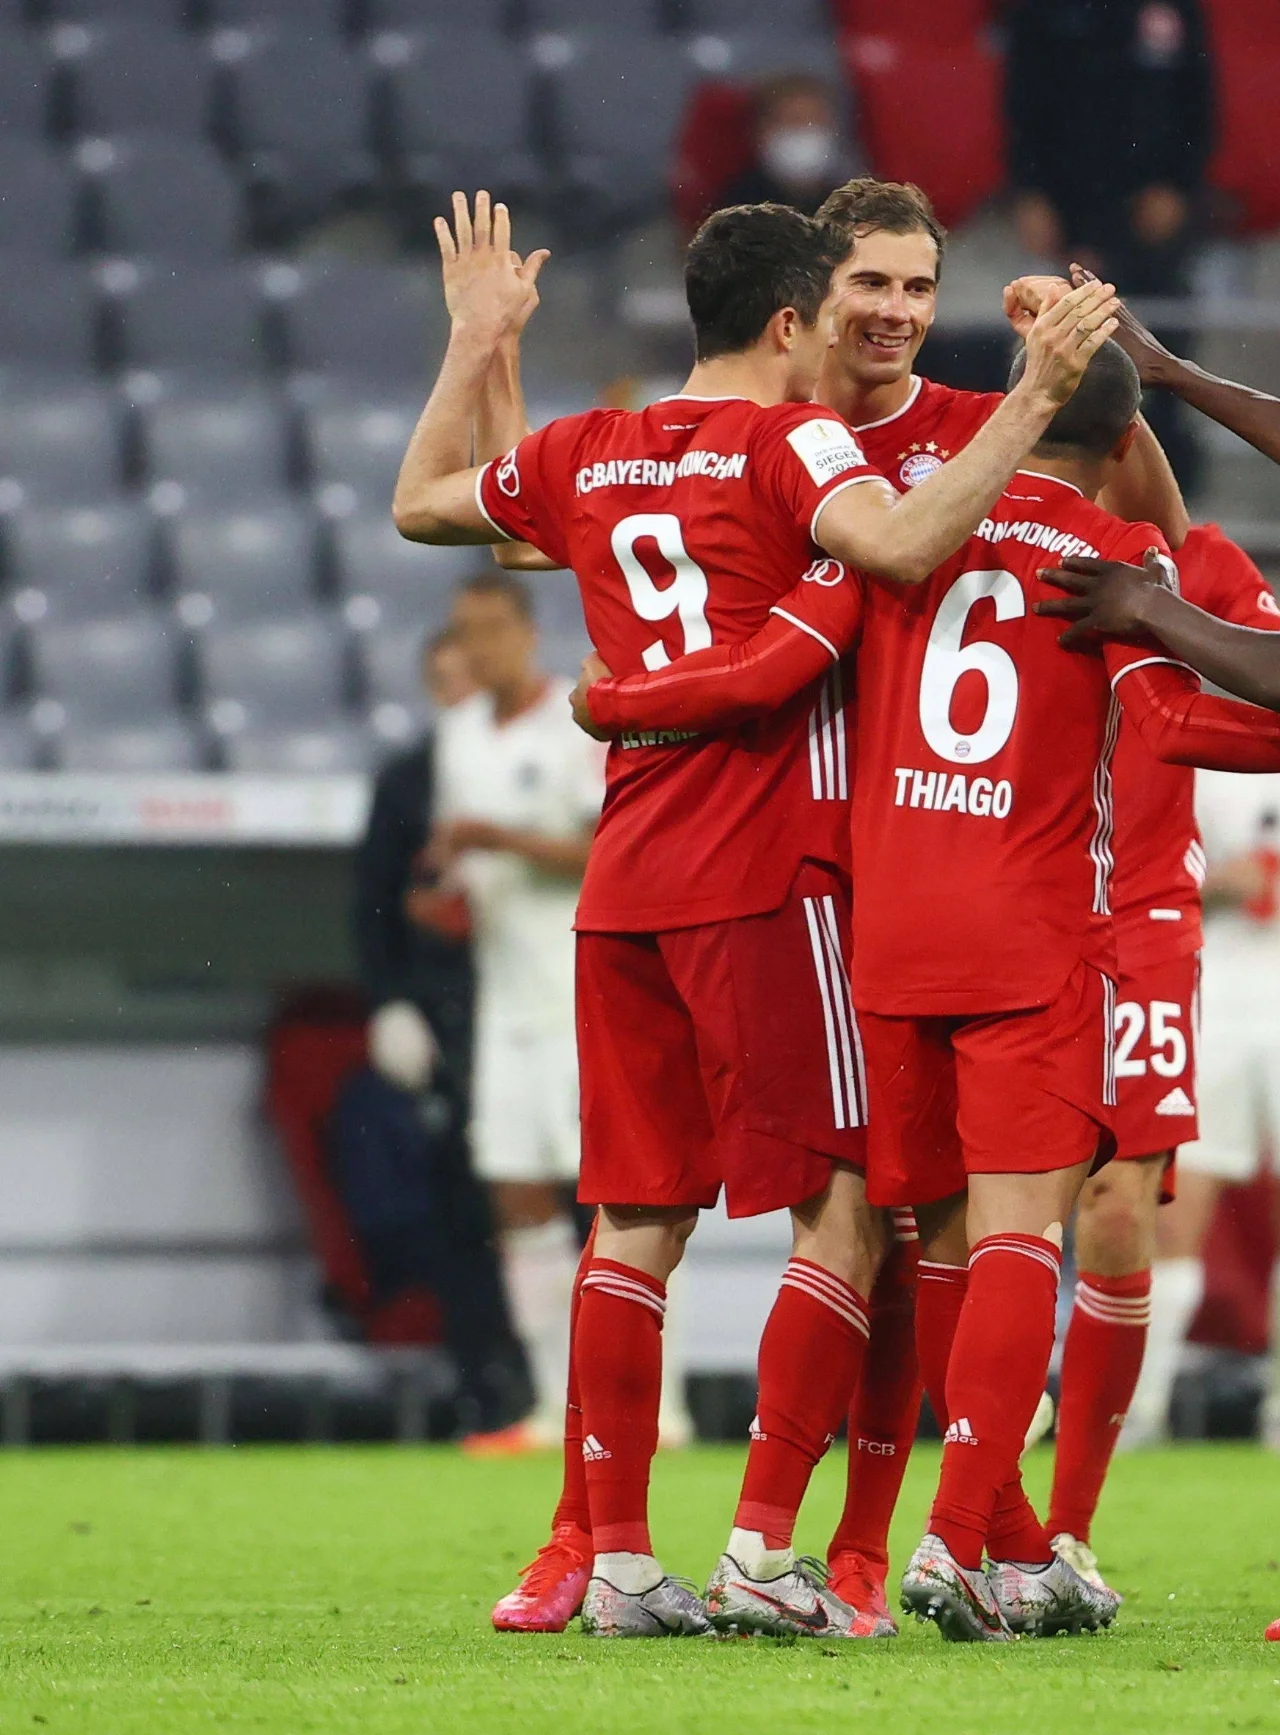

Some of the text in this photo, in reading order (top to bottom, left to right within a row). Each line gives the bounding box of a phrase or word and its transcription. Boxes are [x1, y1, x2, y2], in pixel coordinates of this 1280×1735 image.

[592, 459, 676, 487] BAYERN
[815, 450, 859, 470] SIEGER
[611, 514, 712, 671] 9
[919, 570, 1025, 764] 6
[894, 767, 1012, 819] THIAGO
[1114, 1000, 1187, 1078] 25
[857, 1438, 896, 1456] FCB
